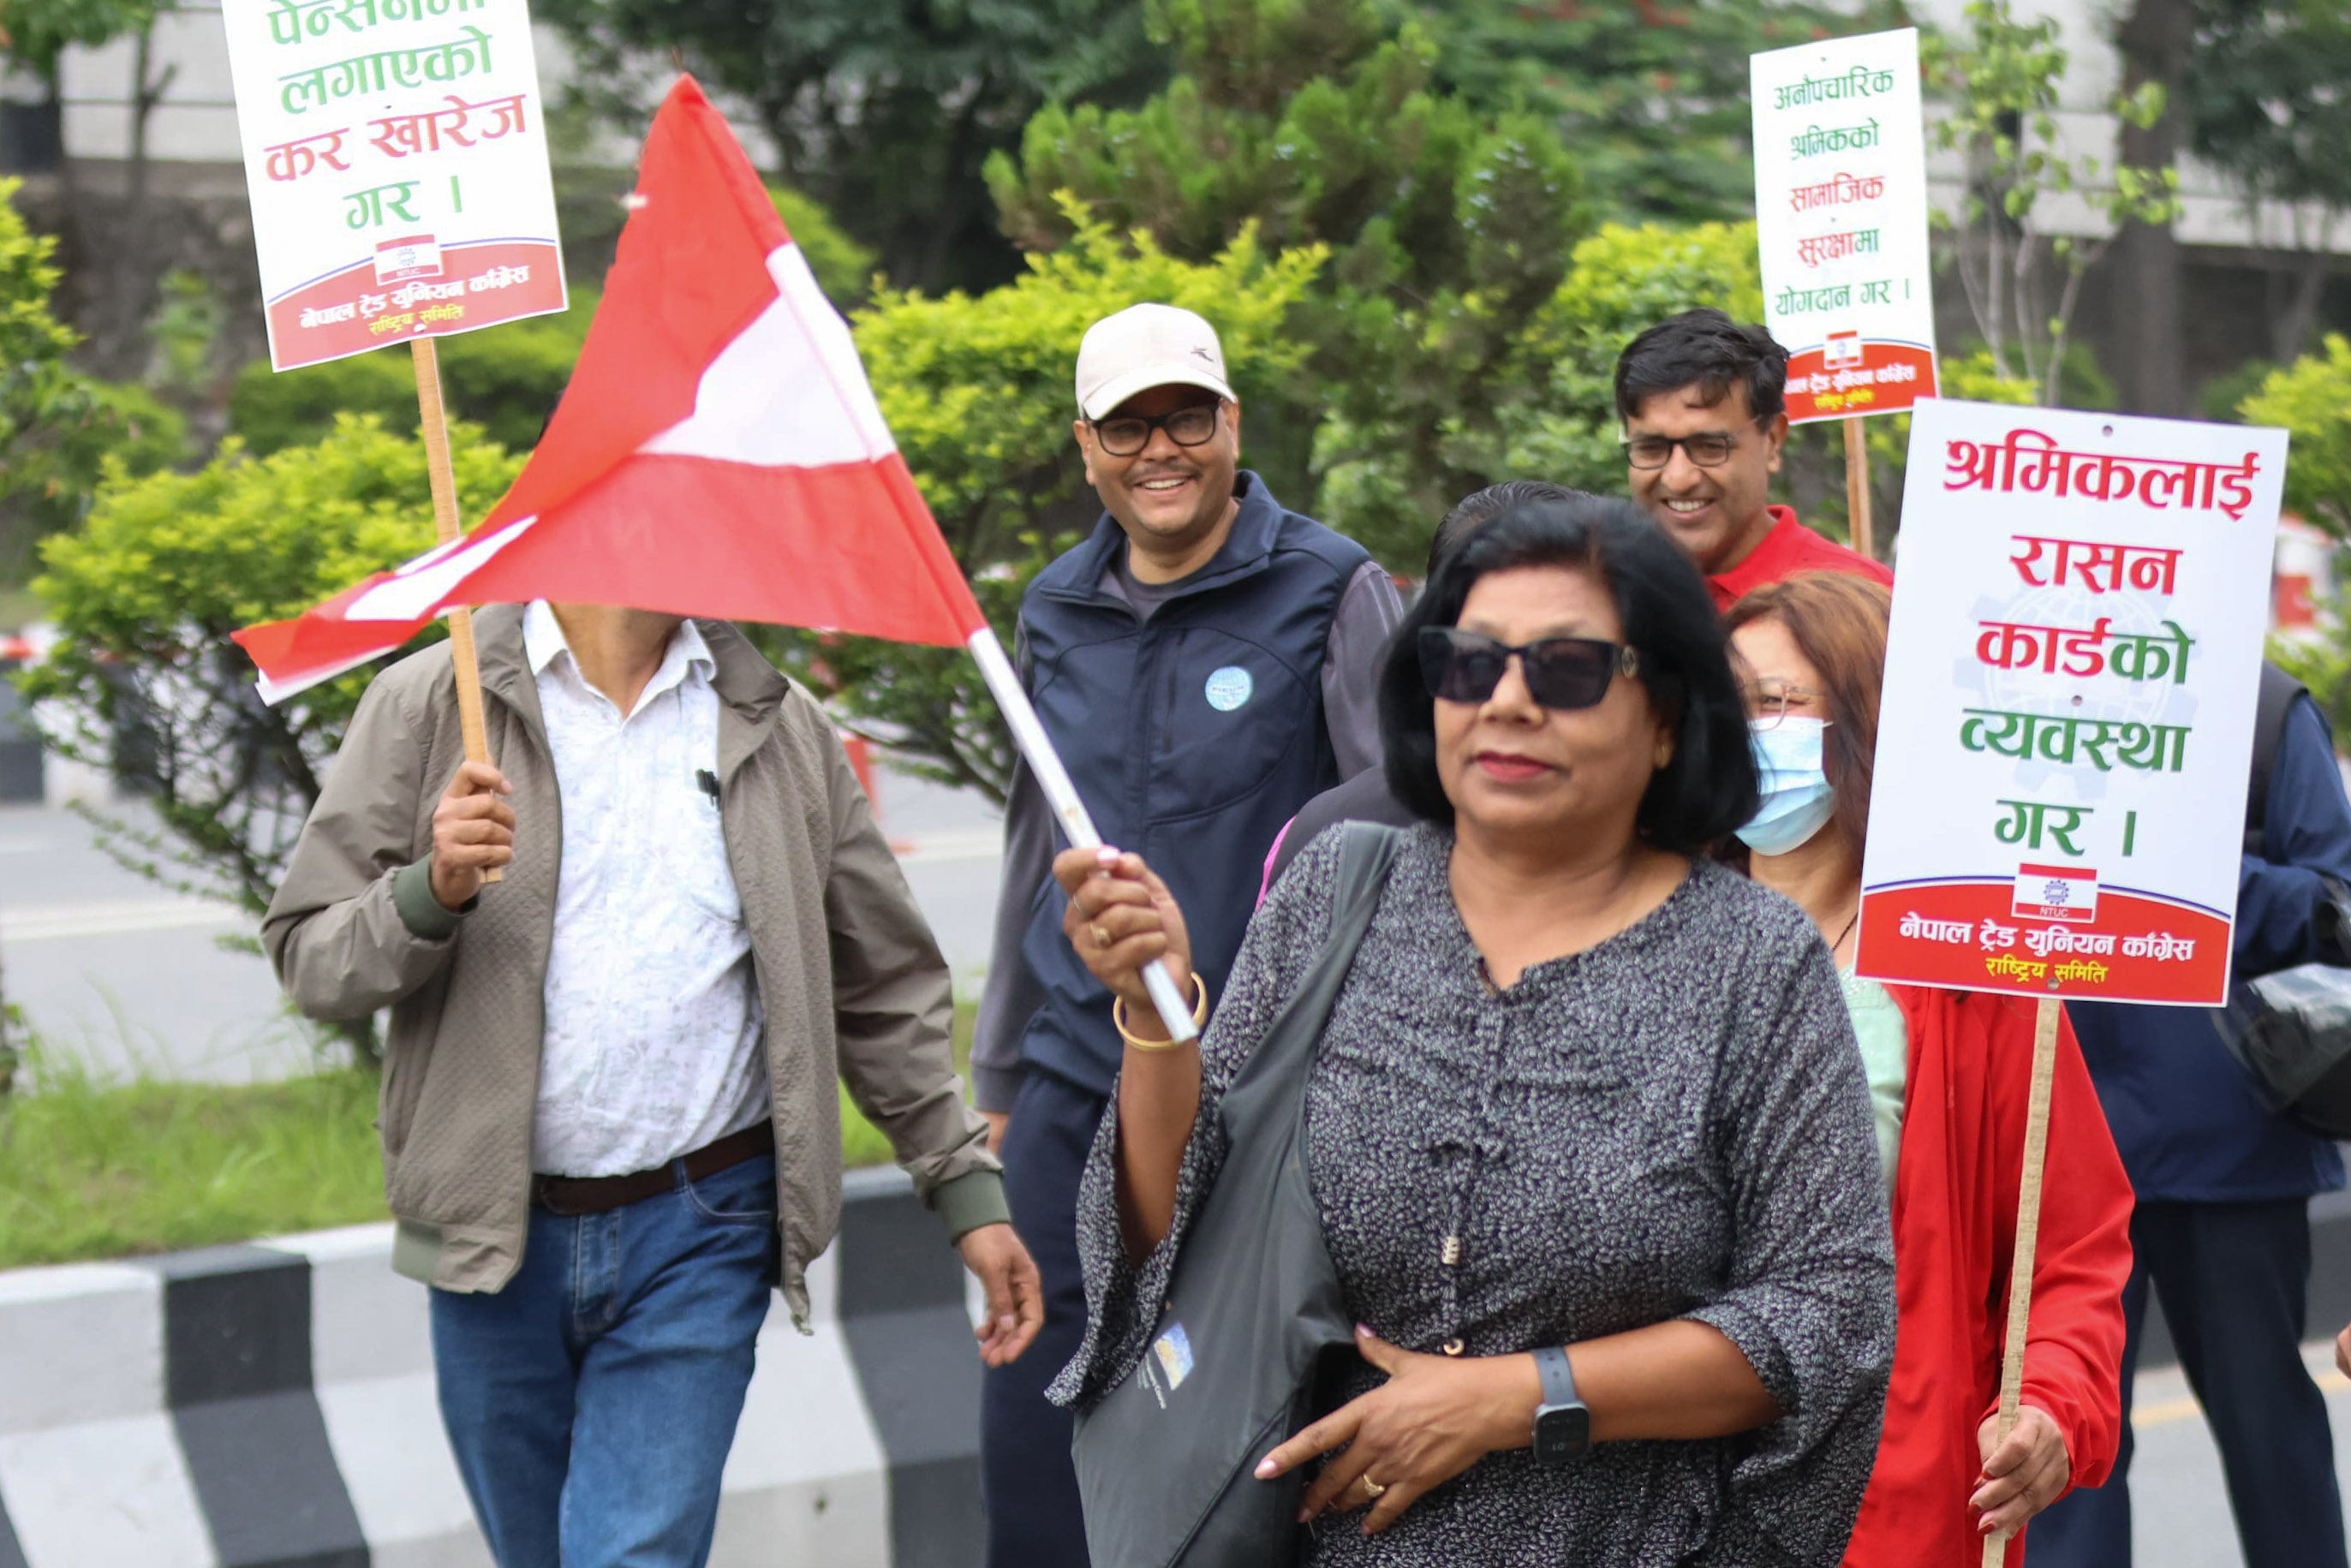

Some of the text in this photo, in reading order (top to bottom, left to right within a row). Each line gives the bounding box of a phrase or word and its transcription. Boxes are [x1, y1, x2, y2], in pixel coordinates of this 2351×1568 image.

[277, 26, 493, 114] लगाएको
[264, 94, 527, 182] कर खारेज
[1791, 117, 1880, 160] श्रमिकको
[343, 181, 421, 230] गर
[1790, 172, 1885, 213] सामाजिक
[1797, 229, 1879, 268] सुरक्षामा
[299, 307, 356, 328] नेपाल
[358, 294, 388, 319] ट्रेड
[391, 280, 465, 309] युनियन
[418, 303, 464, 324] समिति
[1775, 284, 1852, 316] योगदान
[1859, 278, 1893, 304] गर
[1942, 428, 2262, 522] श्रमिकलाई
[2009, 534, 2184, 596] रासन
[1975, 617, 2196, 685] कार्डको
[1960, 708, 2192, 772] व्यवस्था
[1994, 799, 2094, 857] गर
[1899, 911, 1973, 944] नेपाल
[1978, 918, 2019, 951] ट्रेड
[2024, 924, 2117, 957] युनियन
[2039, 906, 2068, 918] NTUC
[1984, 953, 2109, 983] राष्ट्रिय समिति
